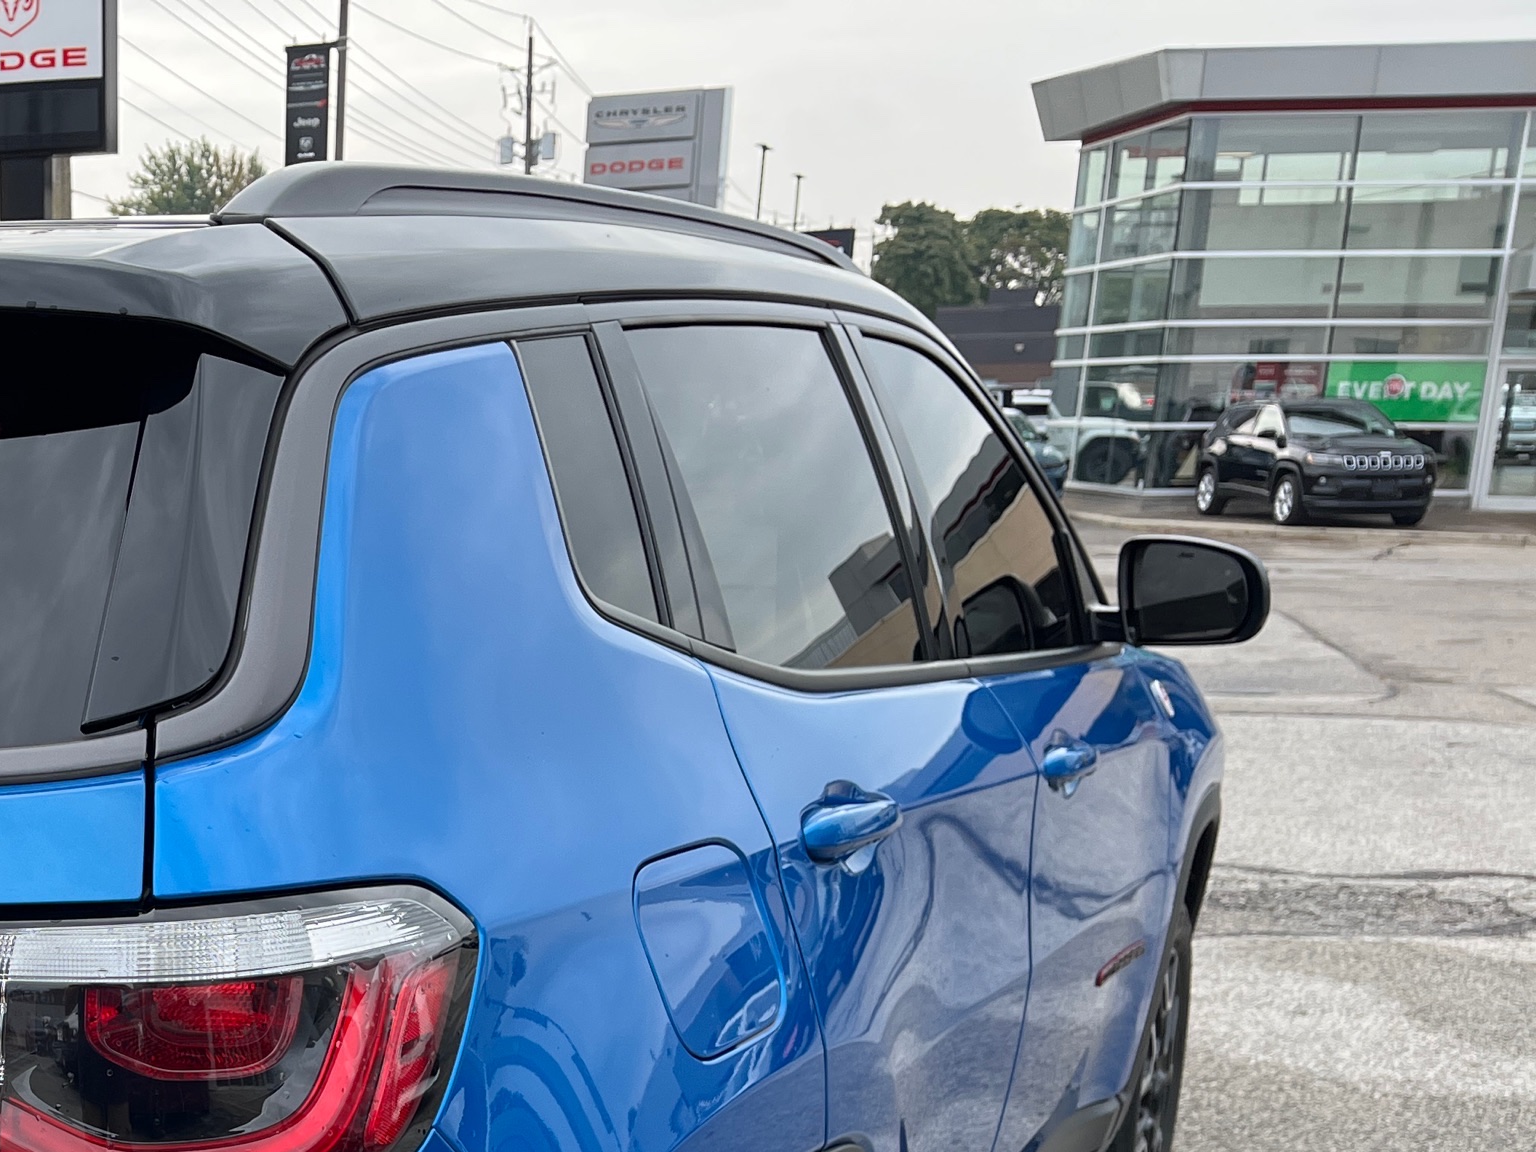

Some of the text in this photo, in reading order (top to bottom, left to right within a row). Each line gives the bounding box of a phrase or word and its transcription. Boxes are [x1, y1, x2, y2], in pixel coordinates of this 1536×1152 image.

[594, 105, 687, 119] CHRYSLER
[589, 156, 685, 176] DODGE
[1420, 380, 1470, 400] DAY
